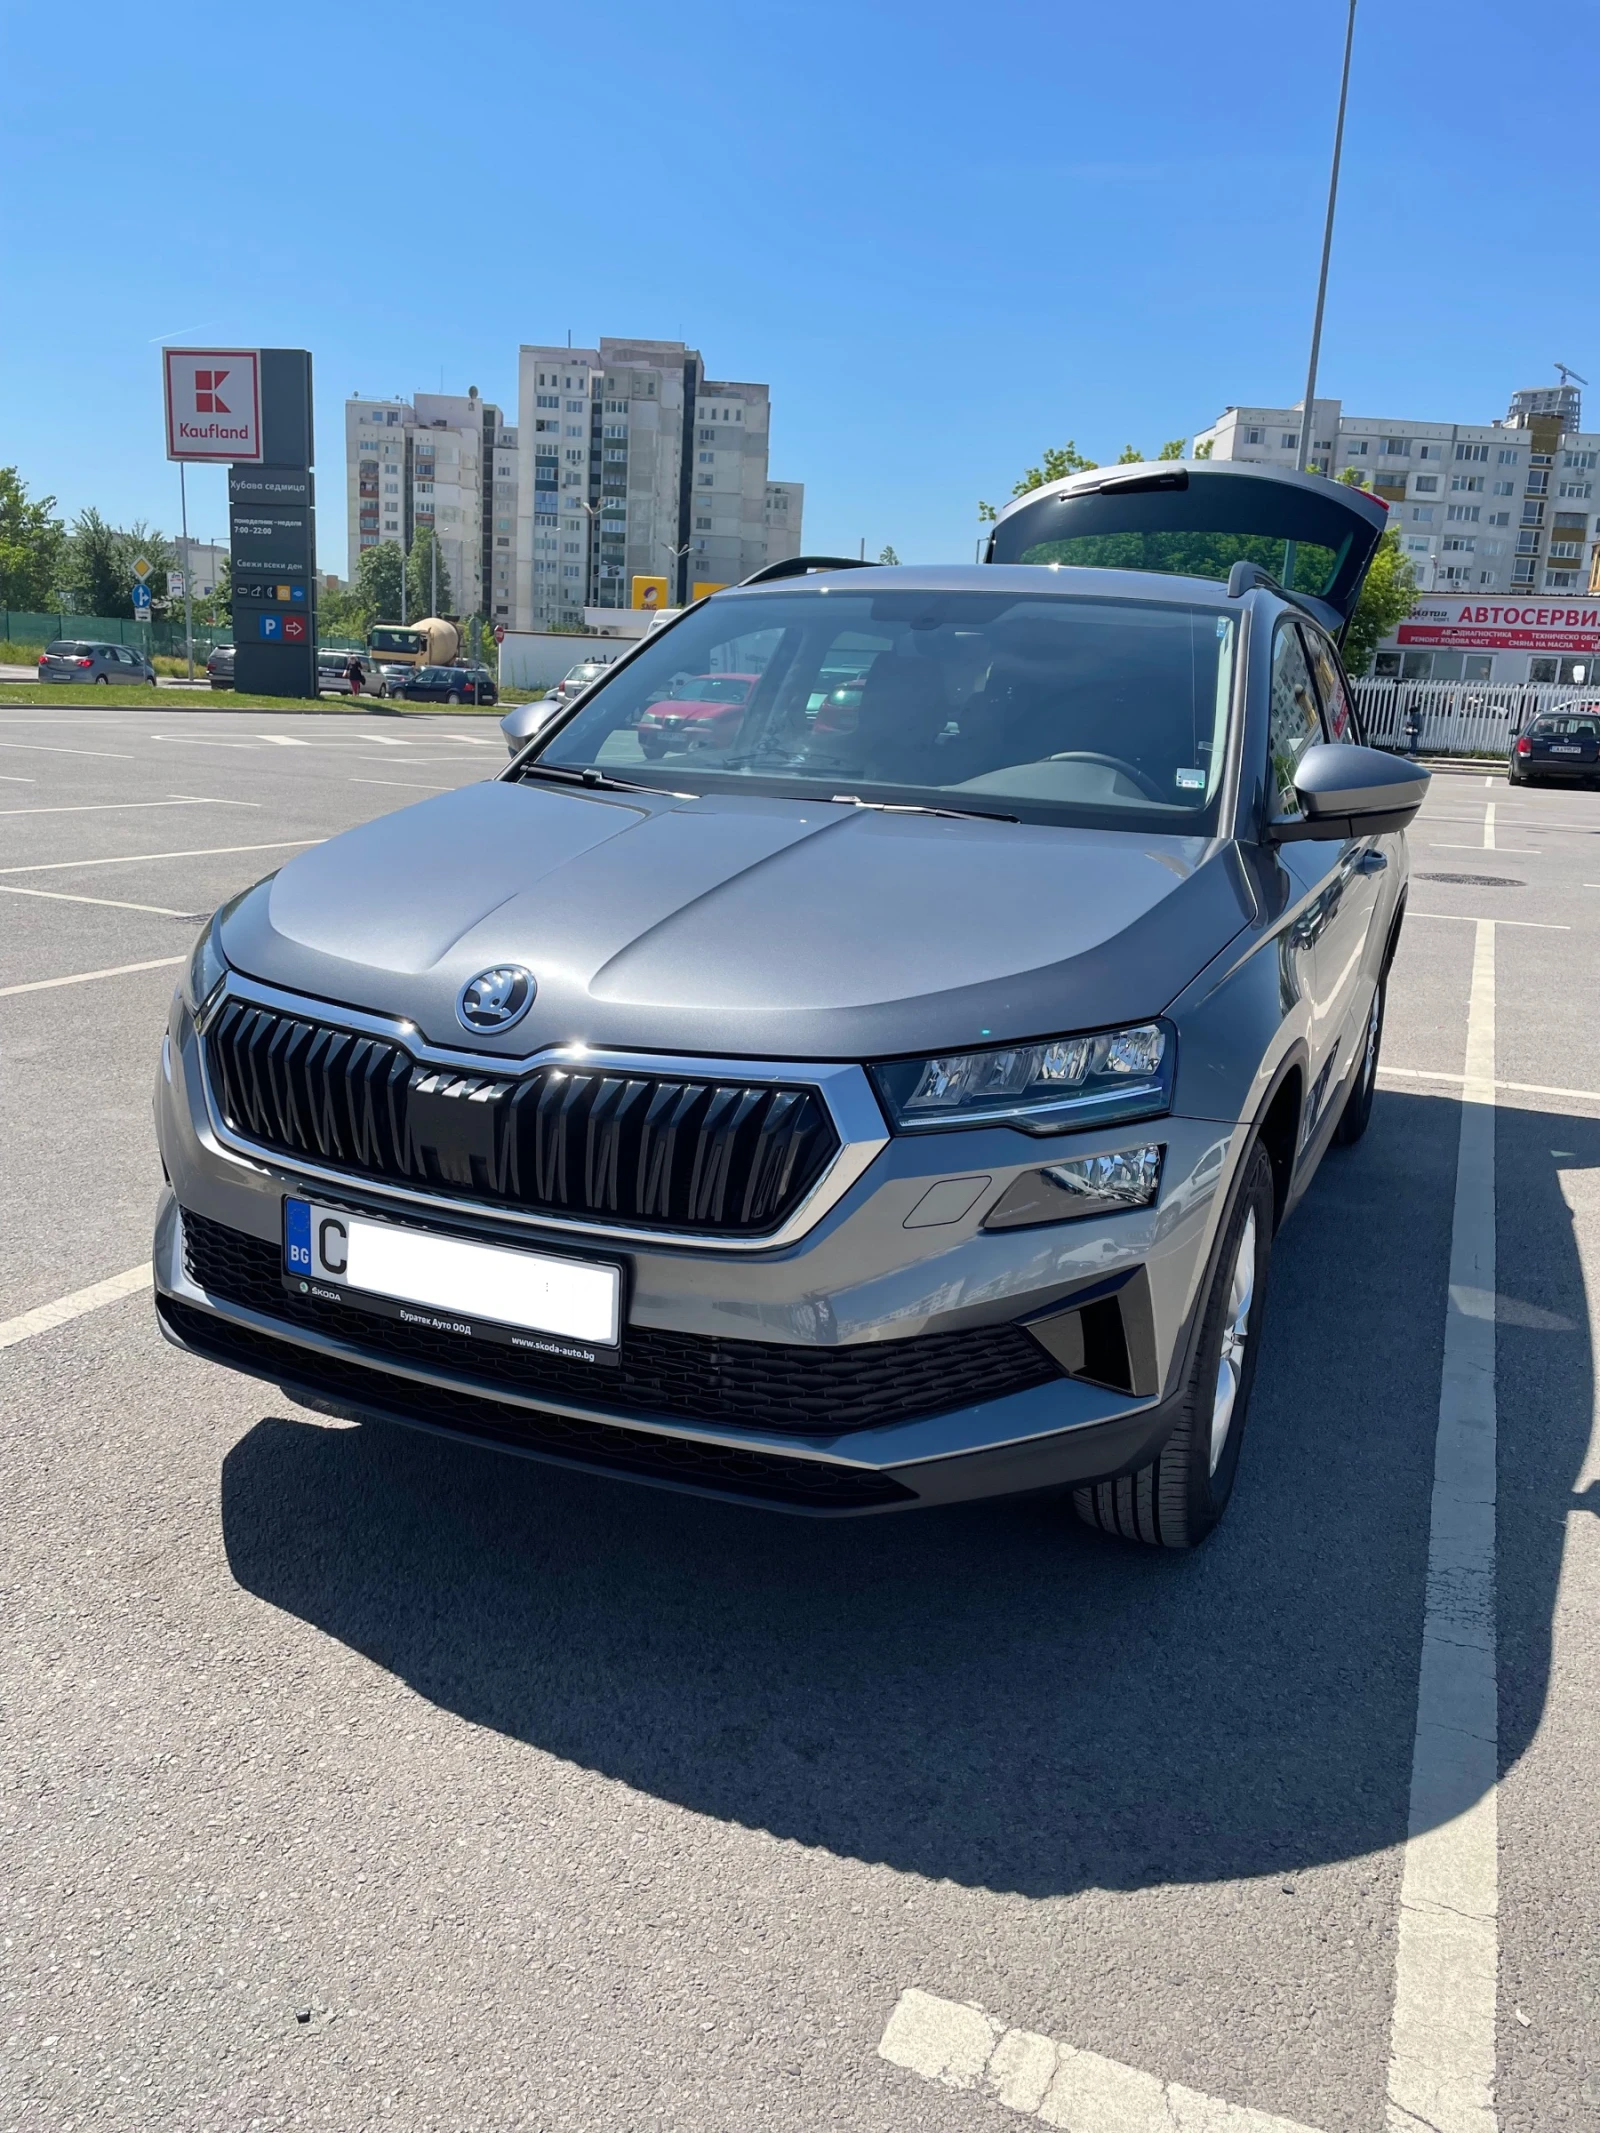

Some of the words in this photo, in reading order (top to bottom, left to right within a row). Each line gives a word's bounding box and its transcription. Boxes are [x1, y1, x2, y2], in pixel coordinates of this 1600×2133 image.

[179, 422, 249, 440] Kaufland
[230, 480, 263, 491] Хубава
[264, 483, 306, 492] седмица
[236, 559, 262, 568] Свежи
[263, 561, 286, 569] всеки
[1458, 606, 1600, 627] АВТОСЕРВИ
[265, 619, 276, 635] P
[1531, 632, 1579, 640] ТЕХНИЧЕСКО
[290, 1244, 309, 1264] BG
[319, 1218, 347, 1275] C
[311, 1286, 341, 1302] ŠKODA
[400, 1309, 431, 1326] Еуратек
[432, 1318, 452, 1331] Ауто
[452, 1323, 472, 1336] ООД
[511, 1336, 595, 1363] www.skoda-auto.bg
